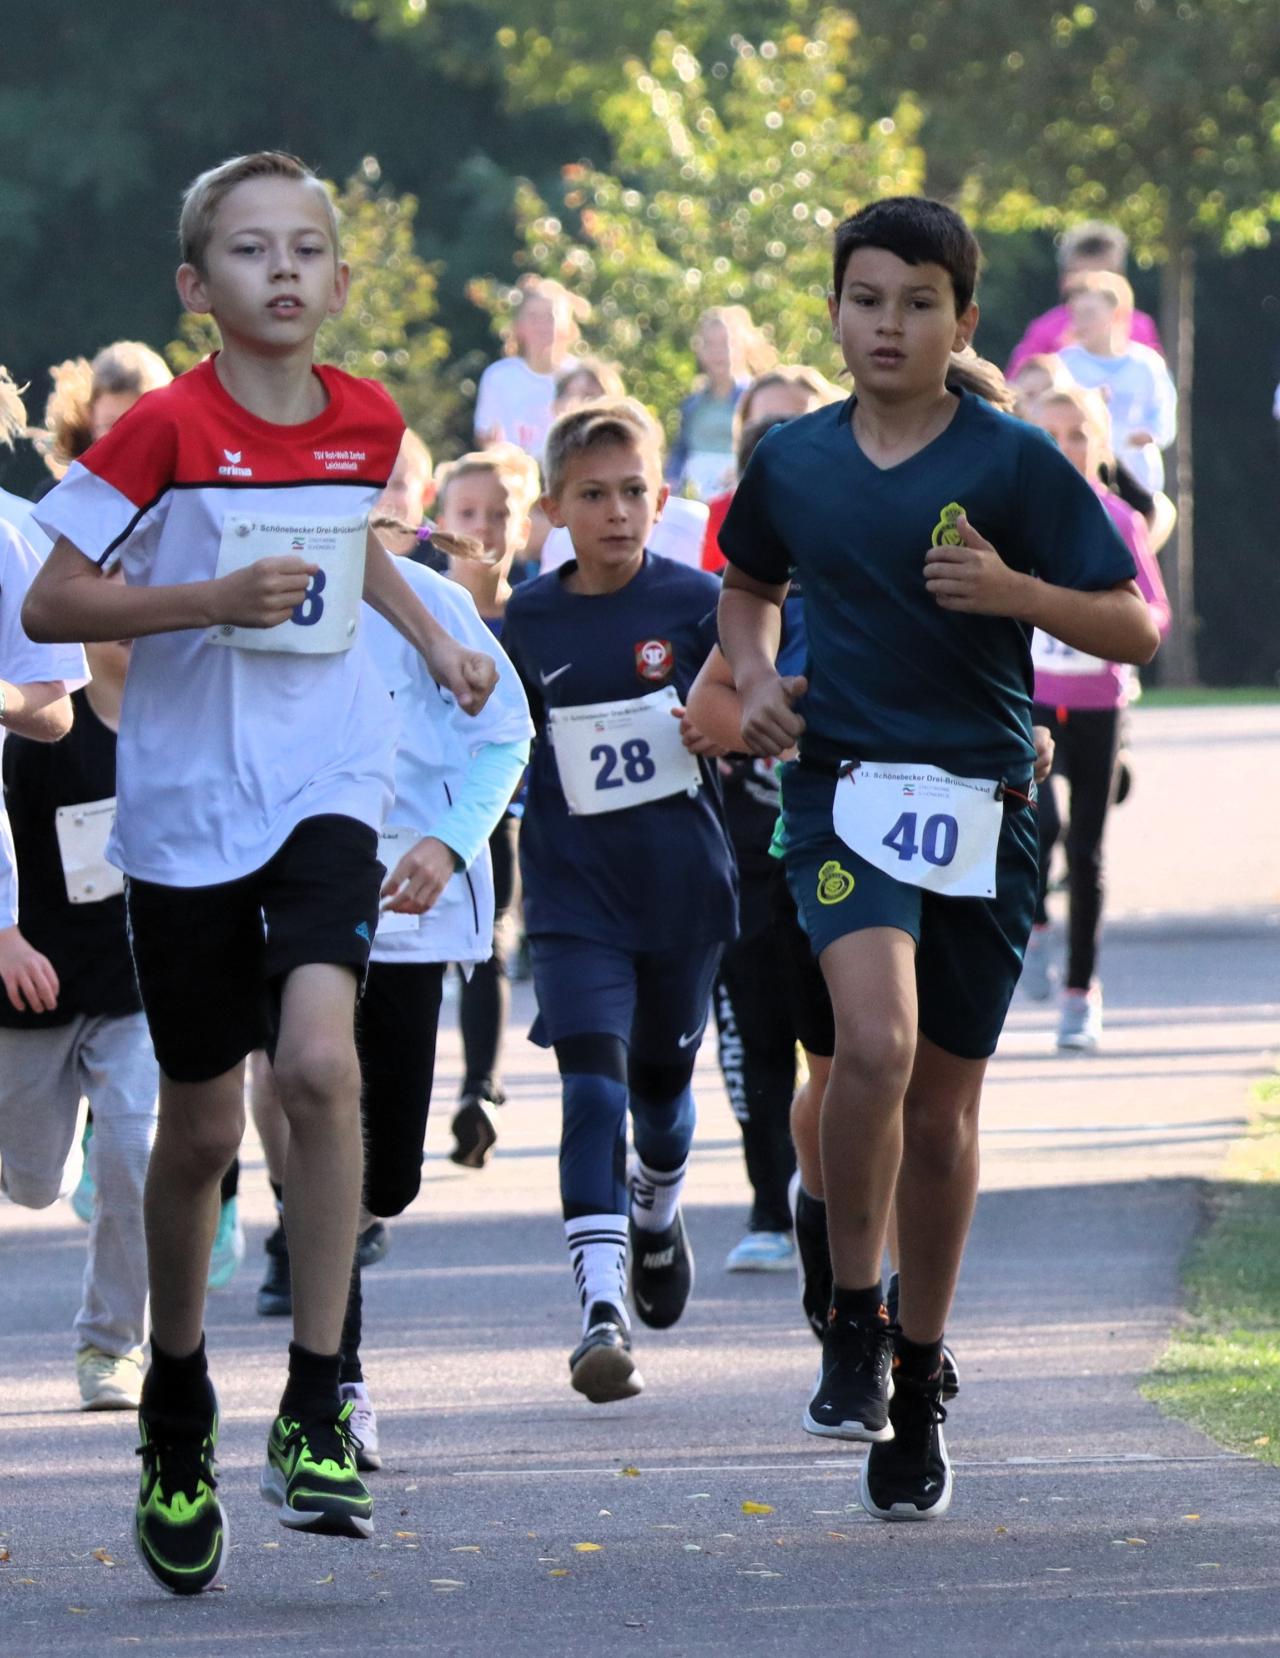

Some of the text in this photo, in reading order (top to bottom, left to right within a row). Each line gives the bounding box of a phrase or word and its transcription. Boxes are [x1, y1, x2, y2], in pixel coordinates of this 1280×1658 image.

[219, 466, 252, 477] erima
[260, 524, 315, 534] Schönebecker
[590, 738, 656, 791] 28
[873, 772, 925, 781] Schönebecker
[882, 812, 959, 867] 40
[642, 1247, 676, 1269] NIKE
